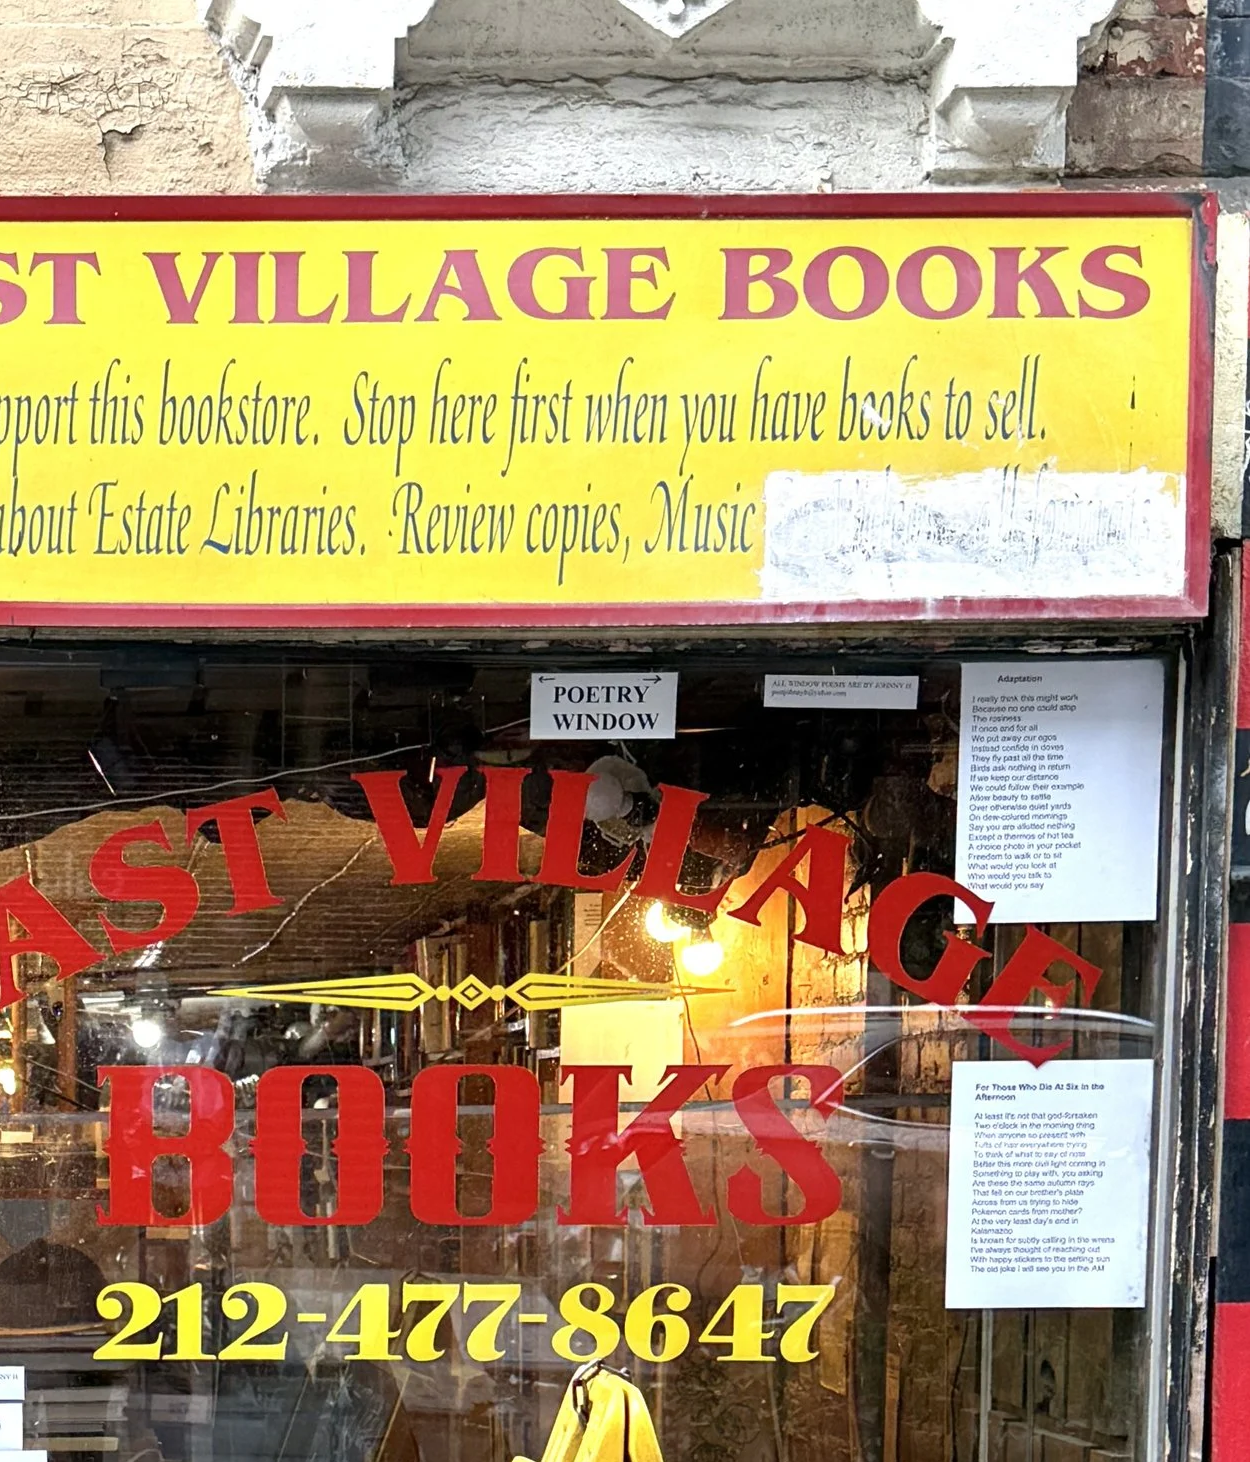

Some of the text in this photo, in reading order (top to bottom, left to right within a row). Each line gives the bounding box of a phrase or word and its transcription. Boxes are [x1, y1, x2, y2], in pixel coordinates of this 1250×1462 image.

[142, 248, 677, 325] VILLAGE
[718, 245, 1151, 321] BOOKS
[90, 359, 145, 447] this
[158, 359, 319, 447] bookstore.
[344, 371, 420, 476] Stop
[429, 358, 496, 445] here
[502, 357, 573, 476] first
[585, 357, 669, 445] when
[679, 400, 736, 476] you
[750, 356, 825, 443] have
[839, 354, 931, 443] books
[944, 376, 974, 441] to
[985, 354, 1046, 441] sell.
[89, 480, 191, 555] Estate
[200, 471, 365, 555] Libraries.
[393, 481, 514, 554] Review
[526, 478, 632, 585] copies,
[644, 479, 755, 554] Music
[553, 686, 650, 704] POETRY
[997, 675, 1042, 684] Adaptation
[553, 713, 659, 732] WINDOW
[353, 766, 1104, 1070] VILLAGE
[95, 1063, 849, 1227] BOOKS
[93, 1283, 835, 1364] 212-477-8647
